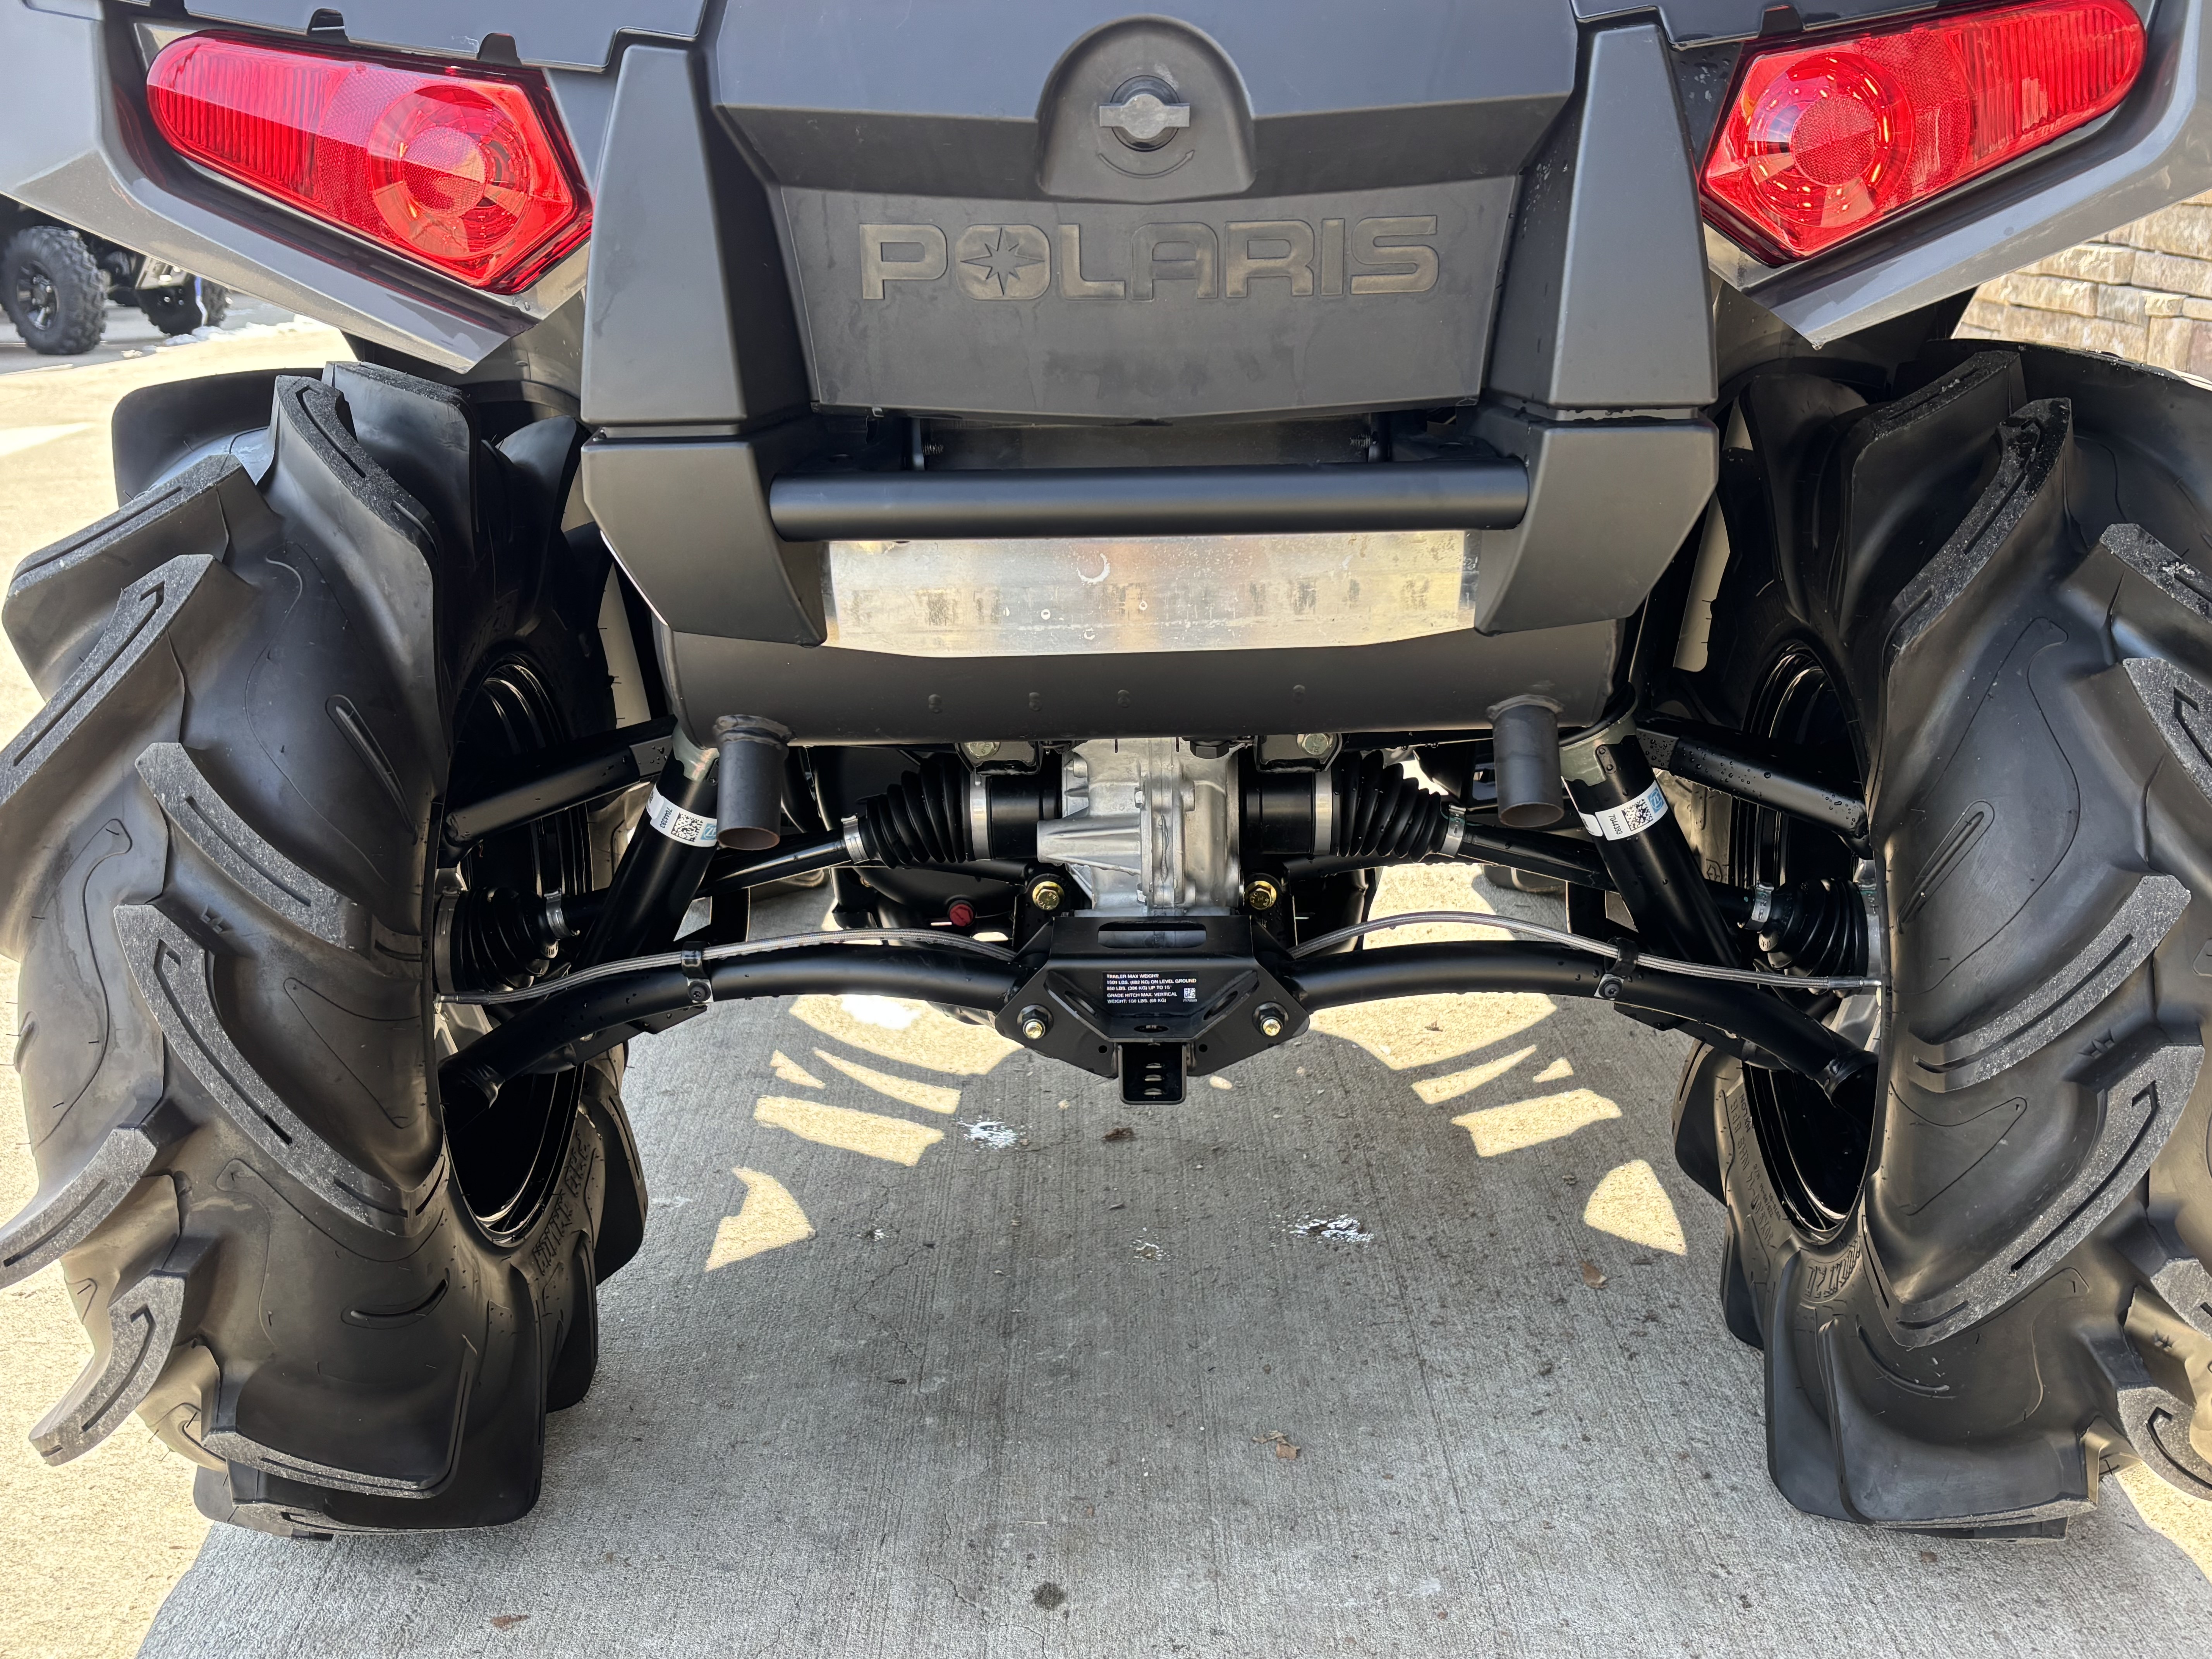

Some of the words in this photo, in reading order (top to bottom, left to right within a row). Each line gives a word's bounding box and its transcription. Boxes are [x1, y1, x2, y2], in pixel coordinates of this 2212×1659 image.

[859, 215, 1439, 301] POLARIS
[659, 807, 673, 828] 7044393
[1608, 814, 1623, 835] 7044393
